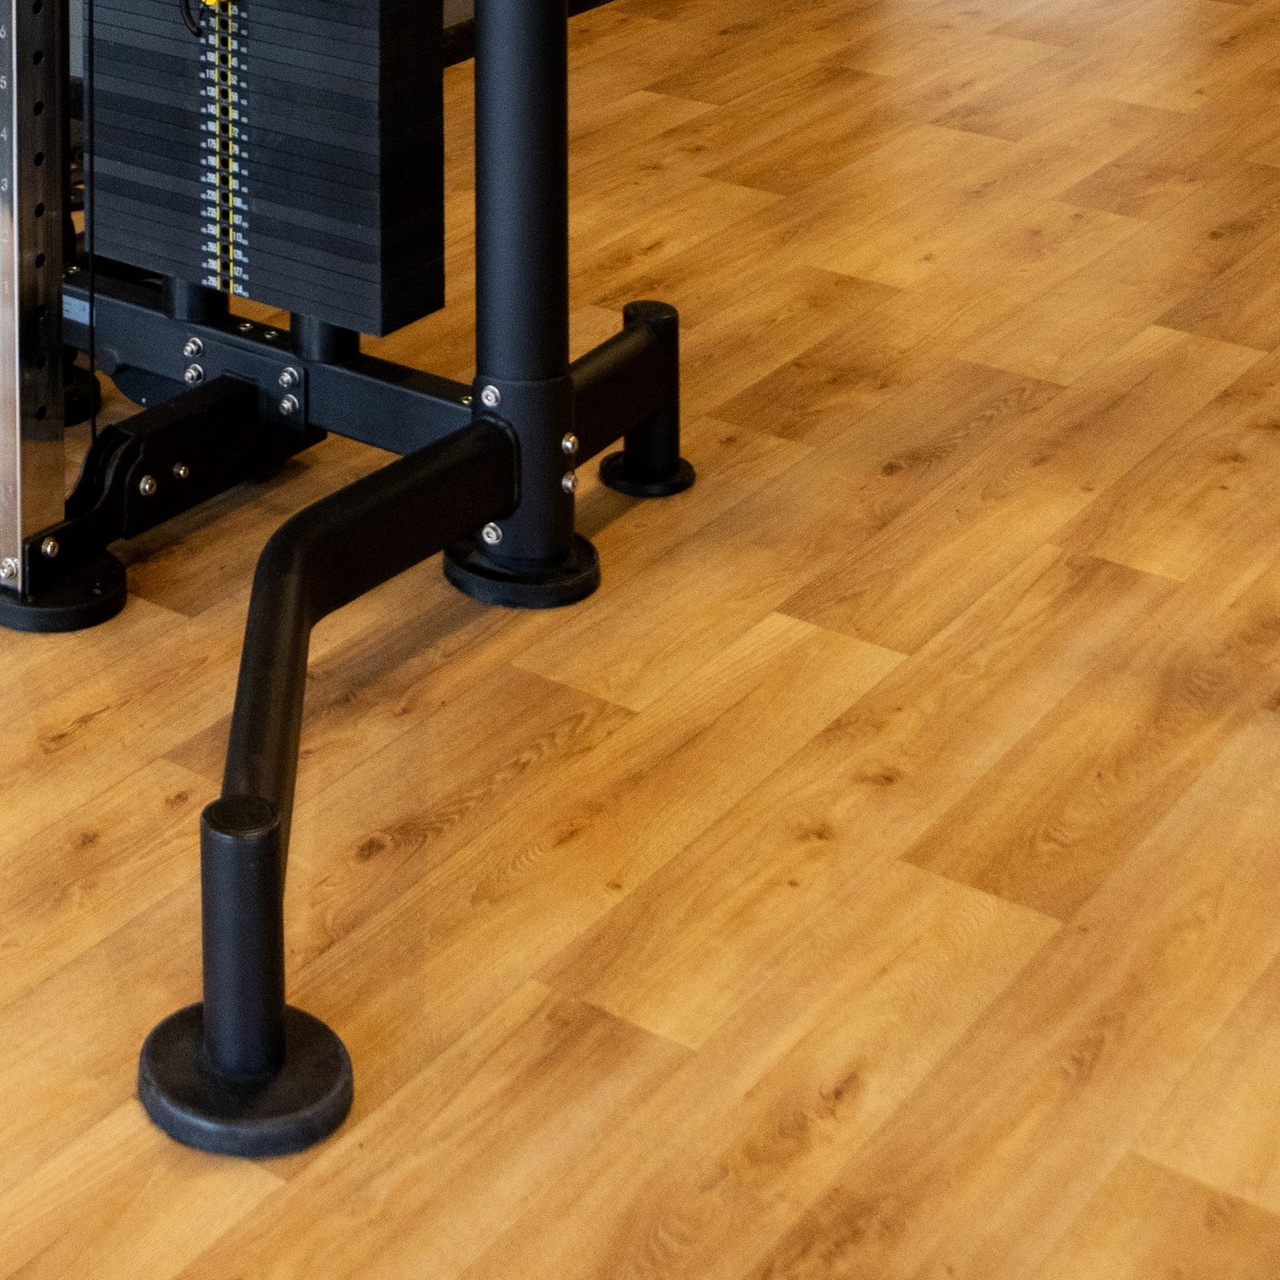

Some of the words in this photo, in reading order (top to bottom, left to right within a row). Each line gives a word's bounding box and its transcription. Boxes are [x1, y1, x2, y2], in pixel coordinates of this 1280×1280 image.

[0, 25, 7, 39] 6
[0, 76, 7, 90] 5
[0, 127, 8, 141] 4
[1, 178, 8, 191] 3
